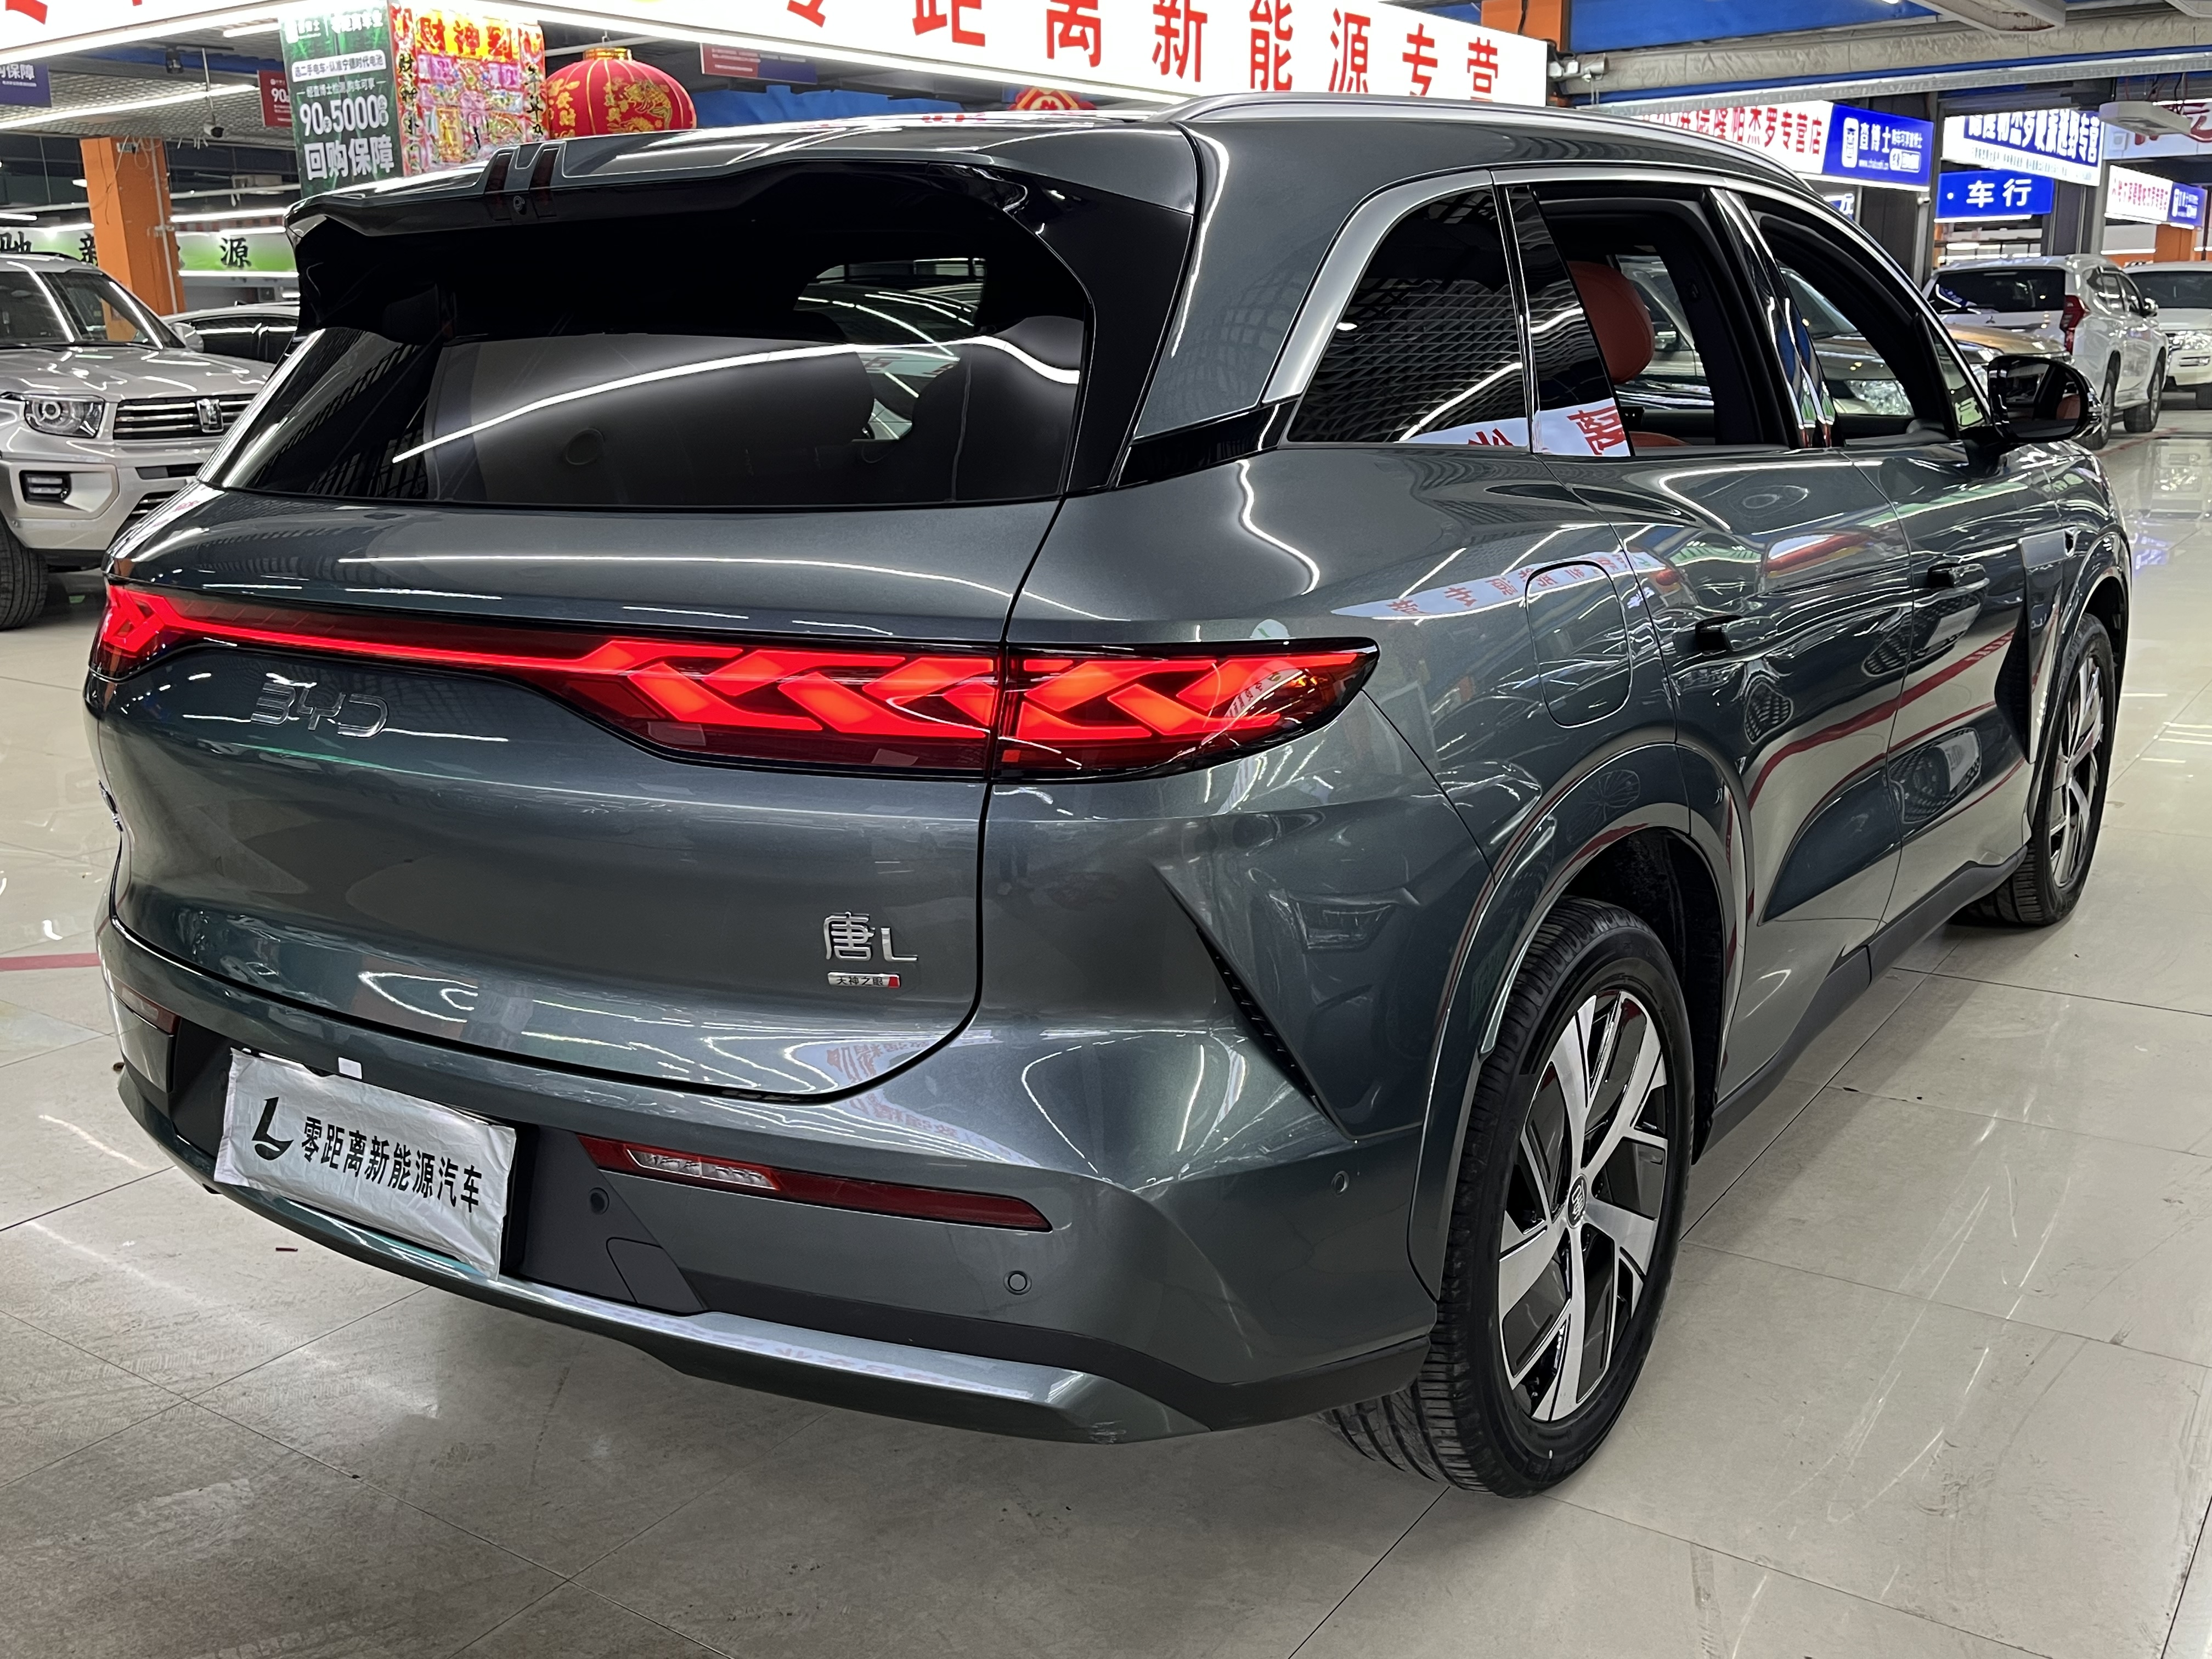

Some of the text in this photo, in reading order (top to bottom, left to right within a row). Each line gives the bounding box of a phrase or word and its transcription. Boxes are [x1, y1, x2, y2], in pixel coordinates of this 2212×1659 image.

[787, 0, 1498, 102] 离新能源专营
[304, 134, 394, 180] 回购保障
[1859, 122, 1891, 153] 查博士
[1966, 179, 2032, 208] 车行
[251, 682, 388, 738] BYD
[836, 976, 884, 987] 天神之眼
[301, 1116, 482, 1213] 零距离新能源汽车
